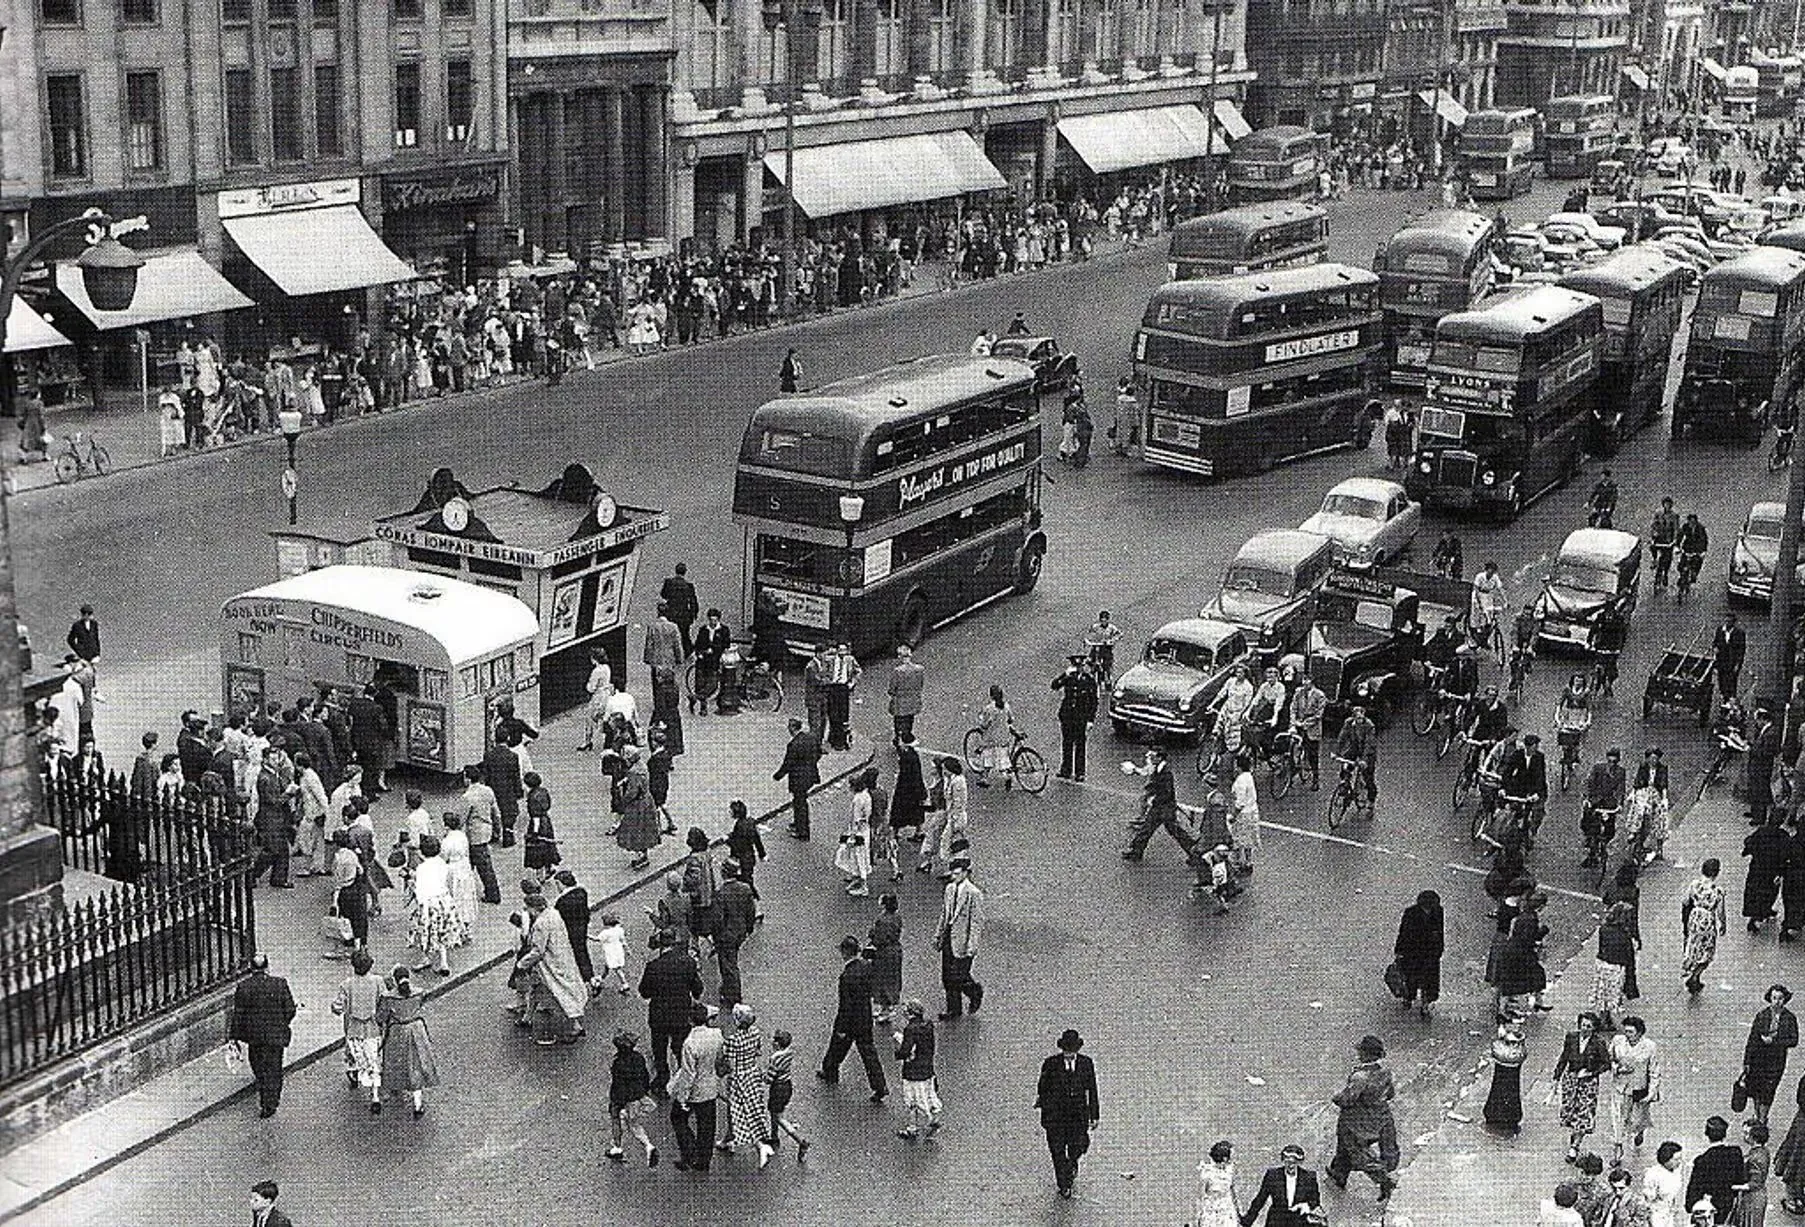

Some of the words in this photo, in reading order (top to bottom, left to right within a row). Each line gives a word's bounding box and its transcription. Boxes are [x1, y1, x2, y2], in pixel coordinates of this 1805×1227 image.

[1450, 376, 1491, 388] LYONS
[952, 465, 963, 483] ON
[966, 459, 980, 479] TOP
[981, 453, 996, 473] FOR
[997, 442, 1026, 467] QUALITY
[424, 533, 474, 554] IOMPAIR
[553, 536, 606, 563] PASSENGER
[615, 519, 661, 544] ENQUIRIES
[310, 628, 361, 651] CIRCUS
